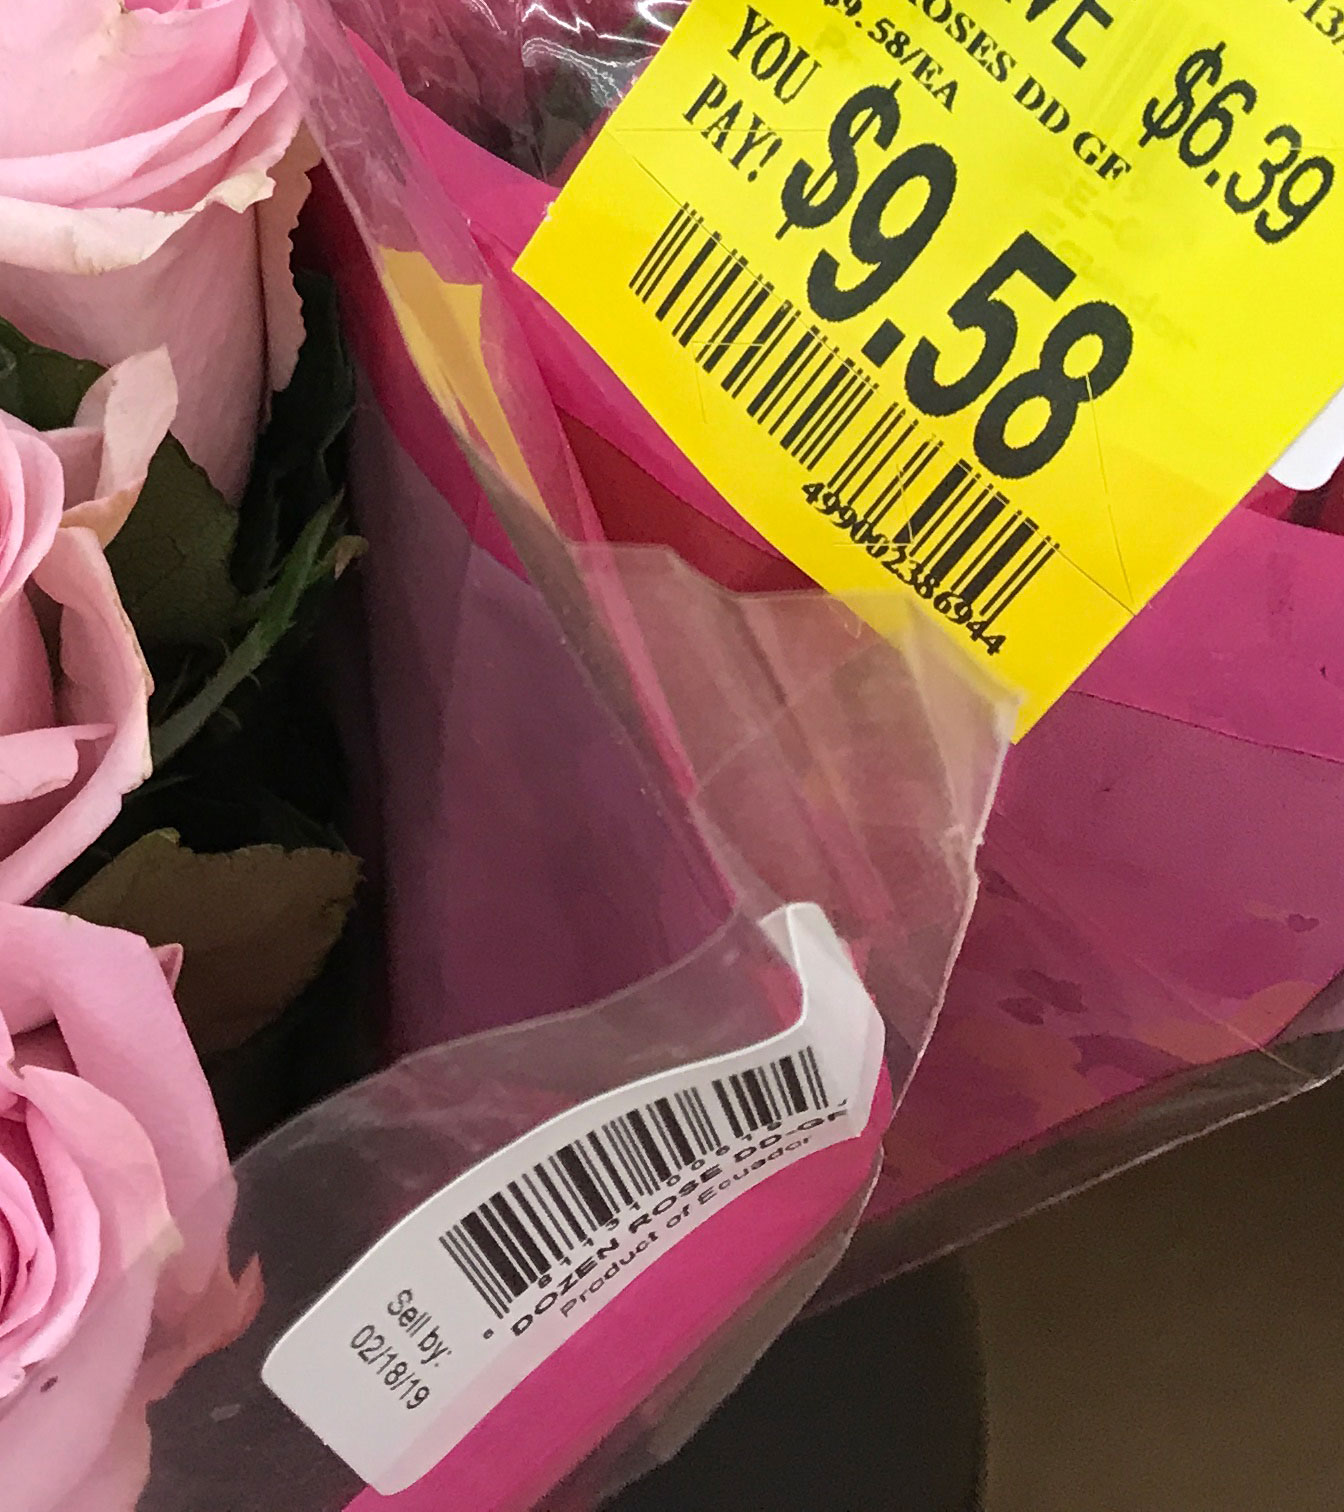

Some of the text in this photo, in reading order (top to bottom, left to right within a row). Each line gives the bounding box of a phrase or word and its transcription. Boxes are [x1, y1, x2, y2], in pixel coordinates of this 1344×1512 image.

[727, 4, 824, 105] YOU
[1012, 73, 1071, 134] DD
[681, 73, 784, 184] PAY!
[1138, 41, 1335, 244] $6.39
[775, 78, 1134, 480] $9.58
[510, 1237, 620, 1336] DOZEN
[628, 1163, 724, 1234] ROSE
[560, 1135, 812, 1317] Product of Ecuador
[350, 1324, 430, 1410] 02/18/19
[387, 1288, 452, 1367] Sell by:
